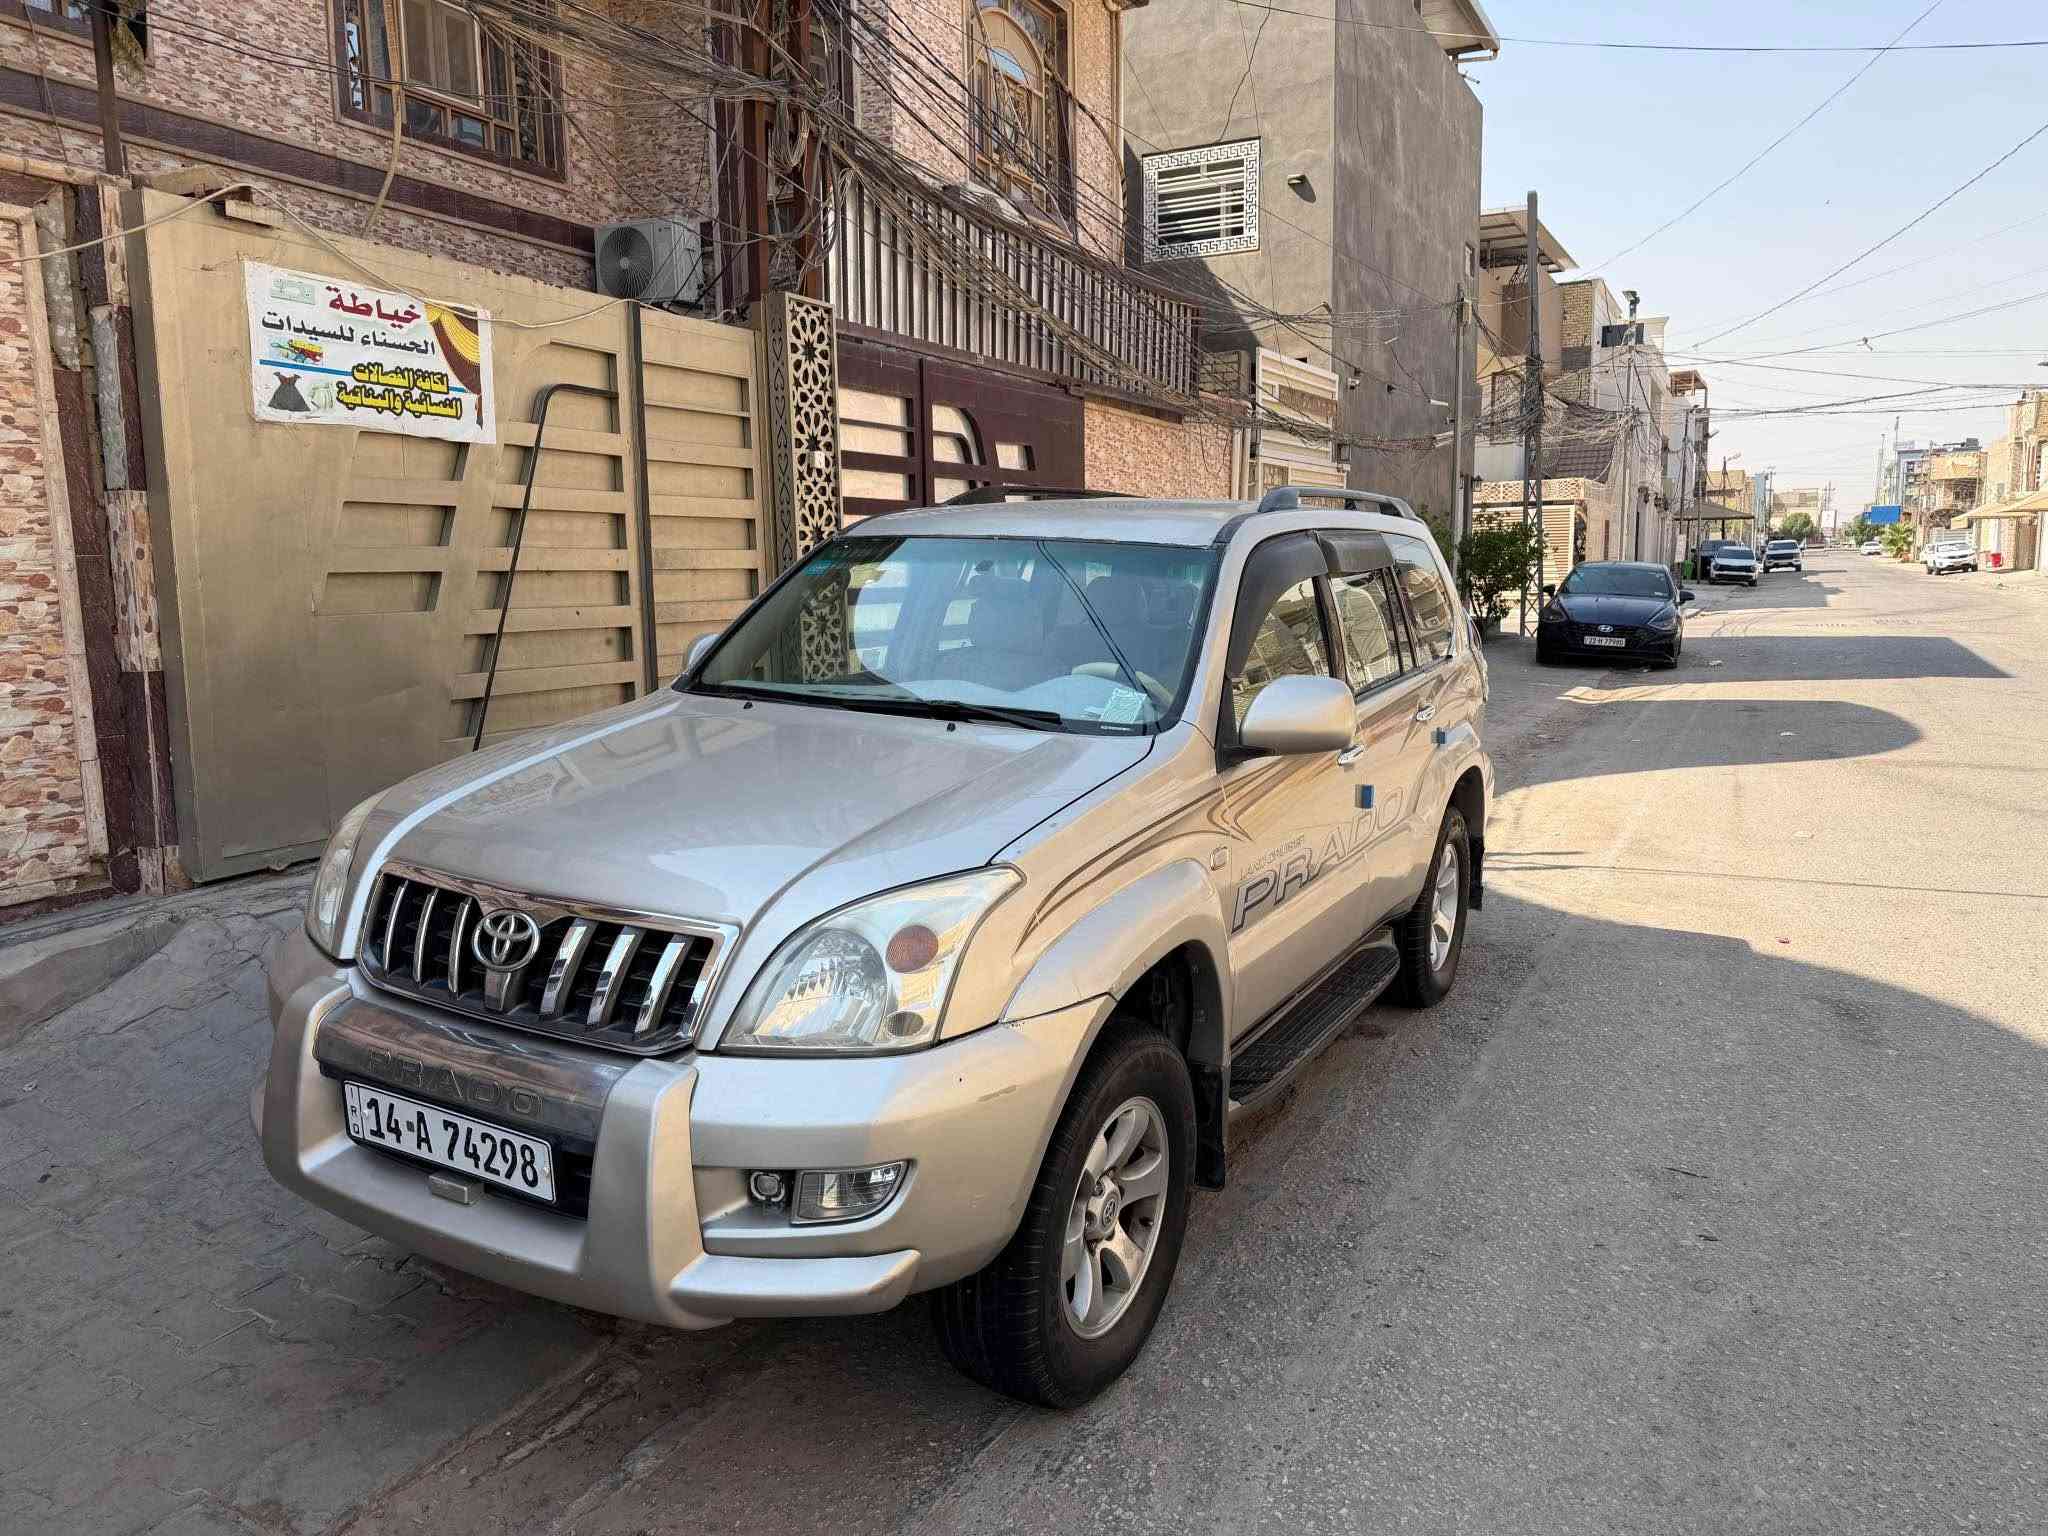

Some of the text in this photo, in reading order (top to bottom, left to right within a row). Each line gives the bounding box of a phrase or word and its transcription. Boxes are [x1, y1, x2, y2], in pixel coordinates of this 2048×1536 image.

[325, 286, 422, 329] خياطة
[262, 311, 436, 356] الحسناء للسيدات
[415, 369, 450, 395] لكافة
[1231, 786, 1404, 935] PRADO
[443, 1119, 540, 1188] 74298
